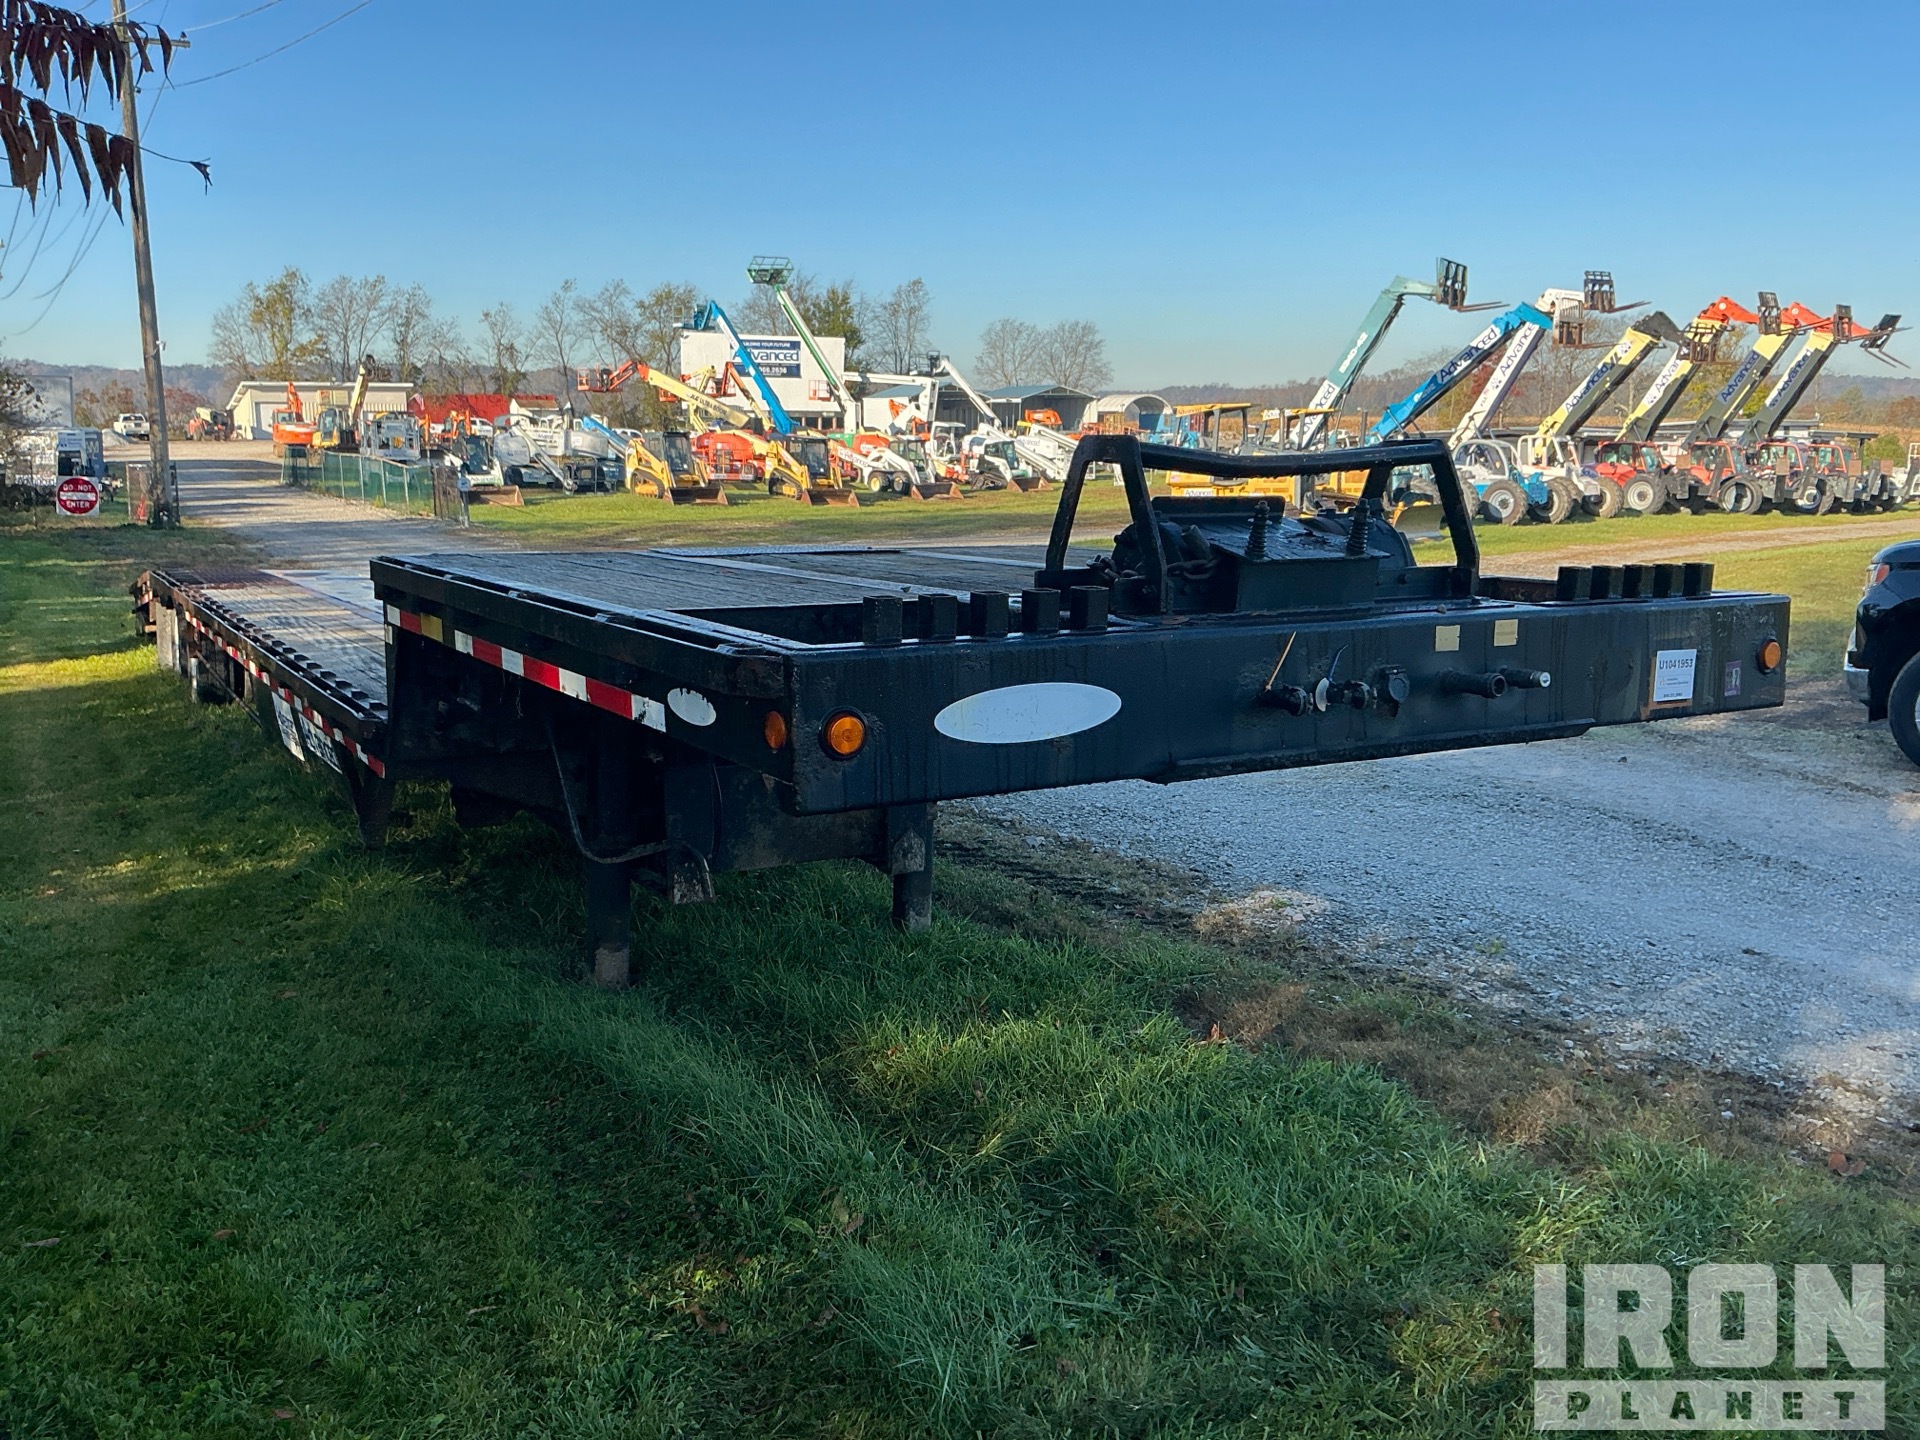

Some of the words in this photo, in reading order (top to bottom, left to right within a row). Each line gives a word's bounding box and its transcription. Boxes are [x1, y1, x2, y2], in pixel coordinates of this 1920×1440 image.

[732, 348, 800, 362] Avanced
[1440, 327, 1498, 383] Advanced
[1499, 323, 1538, 376] Advance
[1778, 349, 1813, 397] Advanced
[1565, 363, 1610, 414] Advanced
[1722, 350, 1759, 402] Advanced
[63, 483, 74, 491] DO
[66, 500, 90, 508] ENTER
[1659, 658, 1693, 670] U1041953
